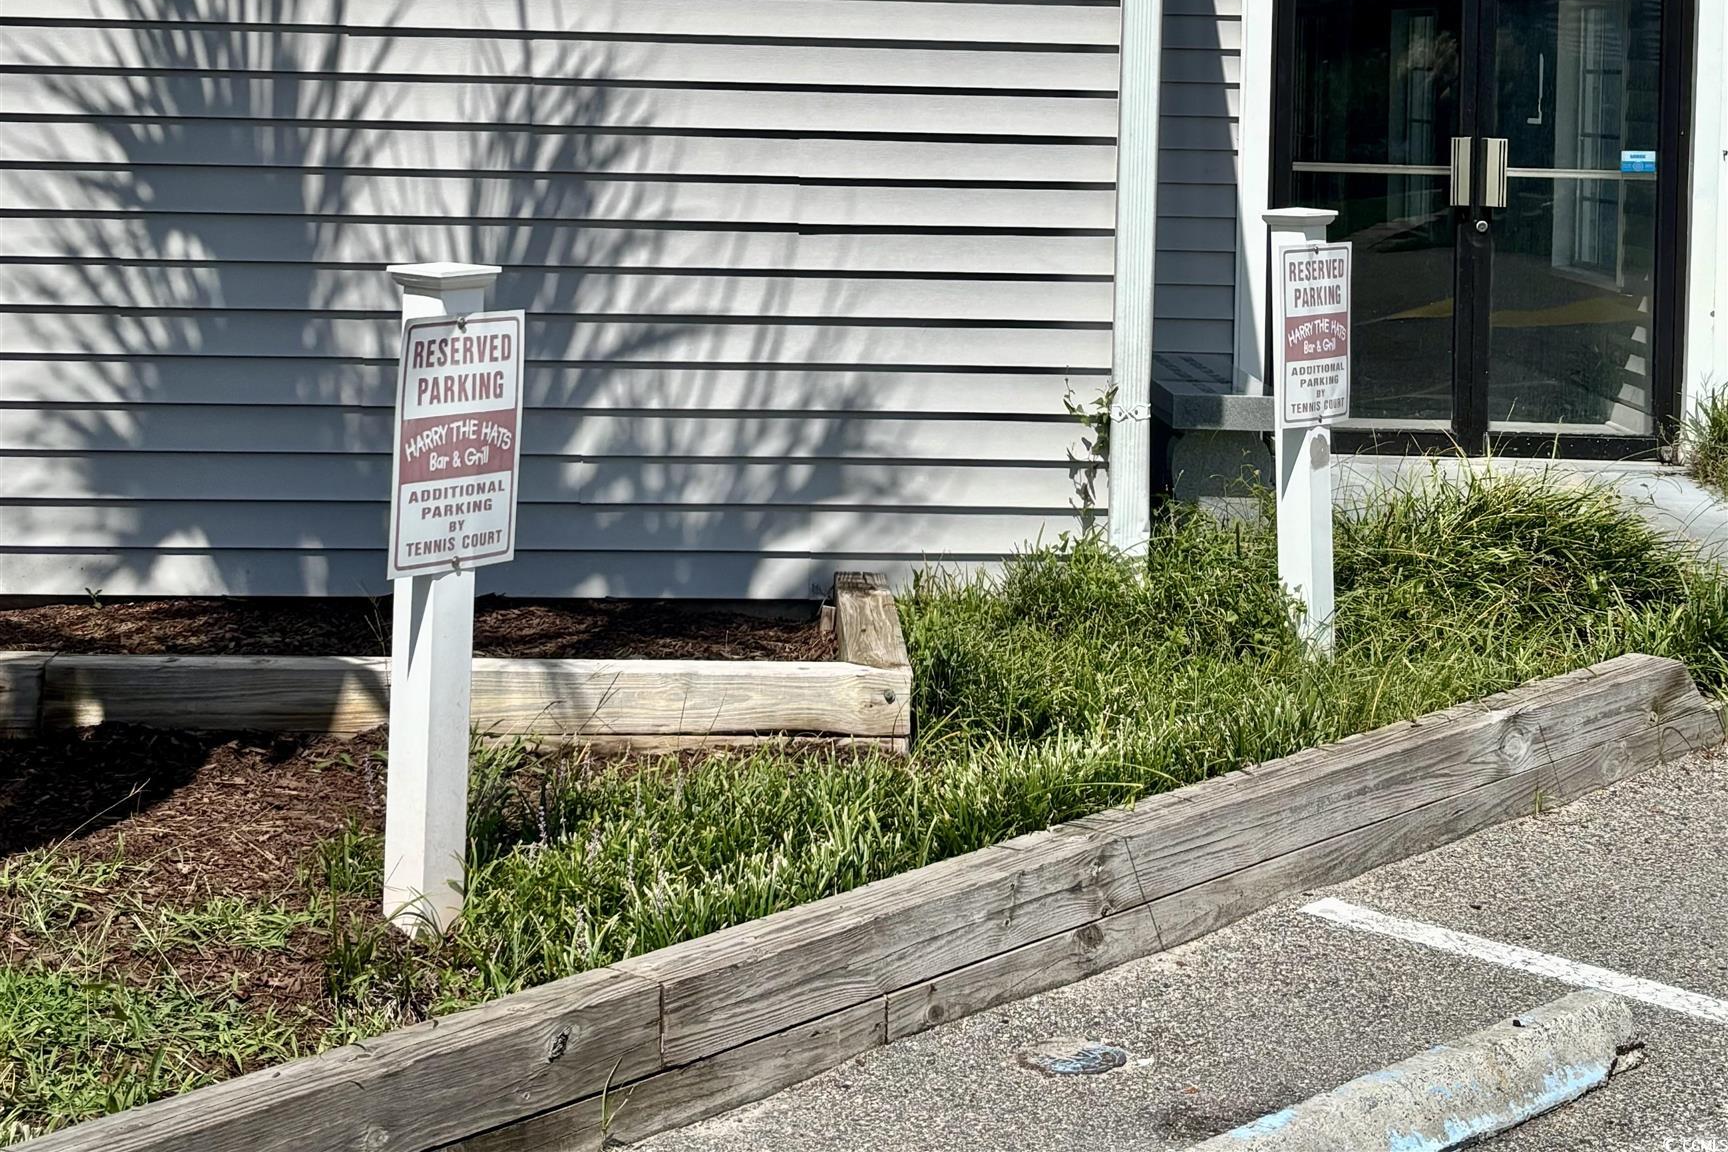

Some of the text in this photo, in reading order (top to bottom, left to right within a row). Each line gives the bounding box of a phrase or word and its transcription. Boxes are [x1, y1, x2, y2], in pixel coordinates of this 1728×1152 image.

[1288, 258, 1345, 283] RESERVED
[1294, 284, 1341, 309] PARKING
[1287, 318, 1347, 347] HARRY THE HATS
[412, 333, 512, 370] RESERVED
[1303, 337, 1336, 355] Bar & Grill
[1291, 361, 1345, 377] ADDITIONAL
[1300, 374, 1339, 388] PARKING
[417, 370, 505, 407] PARKING
[1316, 388, 1326, 398] BY
[1291, 397, 1345, 415] TENNIS COURT
[404, 418, 512, 463] HARRY THE HATS
[429, 445, 490, 472] Bar & Grill
[408, 478, 505, 504] ADDITIONAL
[421, 497, 493, 520] PARKING
[448, 519, 466, 534] BY
[406, 529, 504, 558] TENNIS COURT
